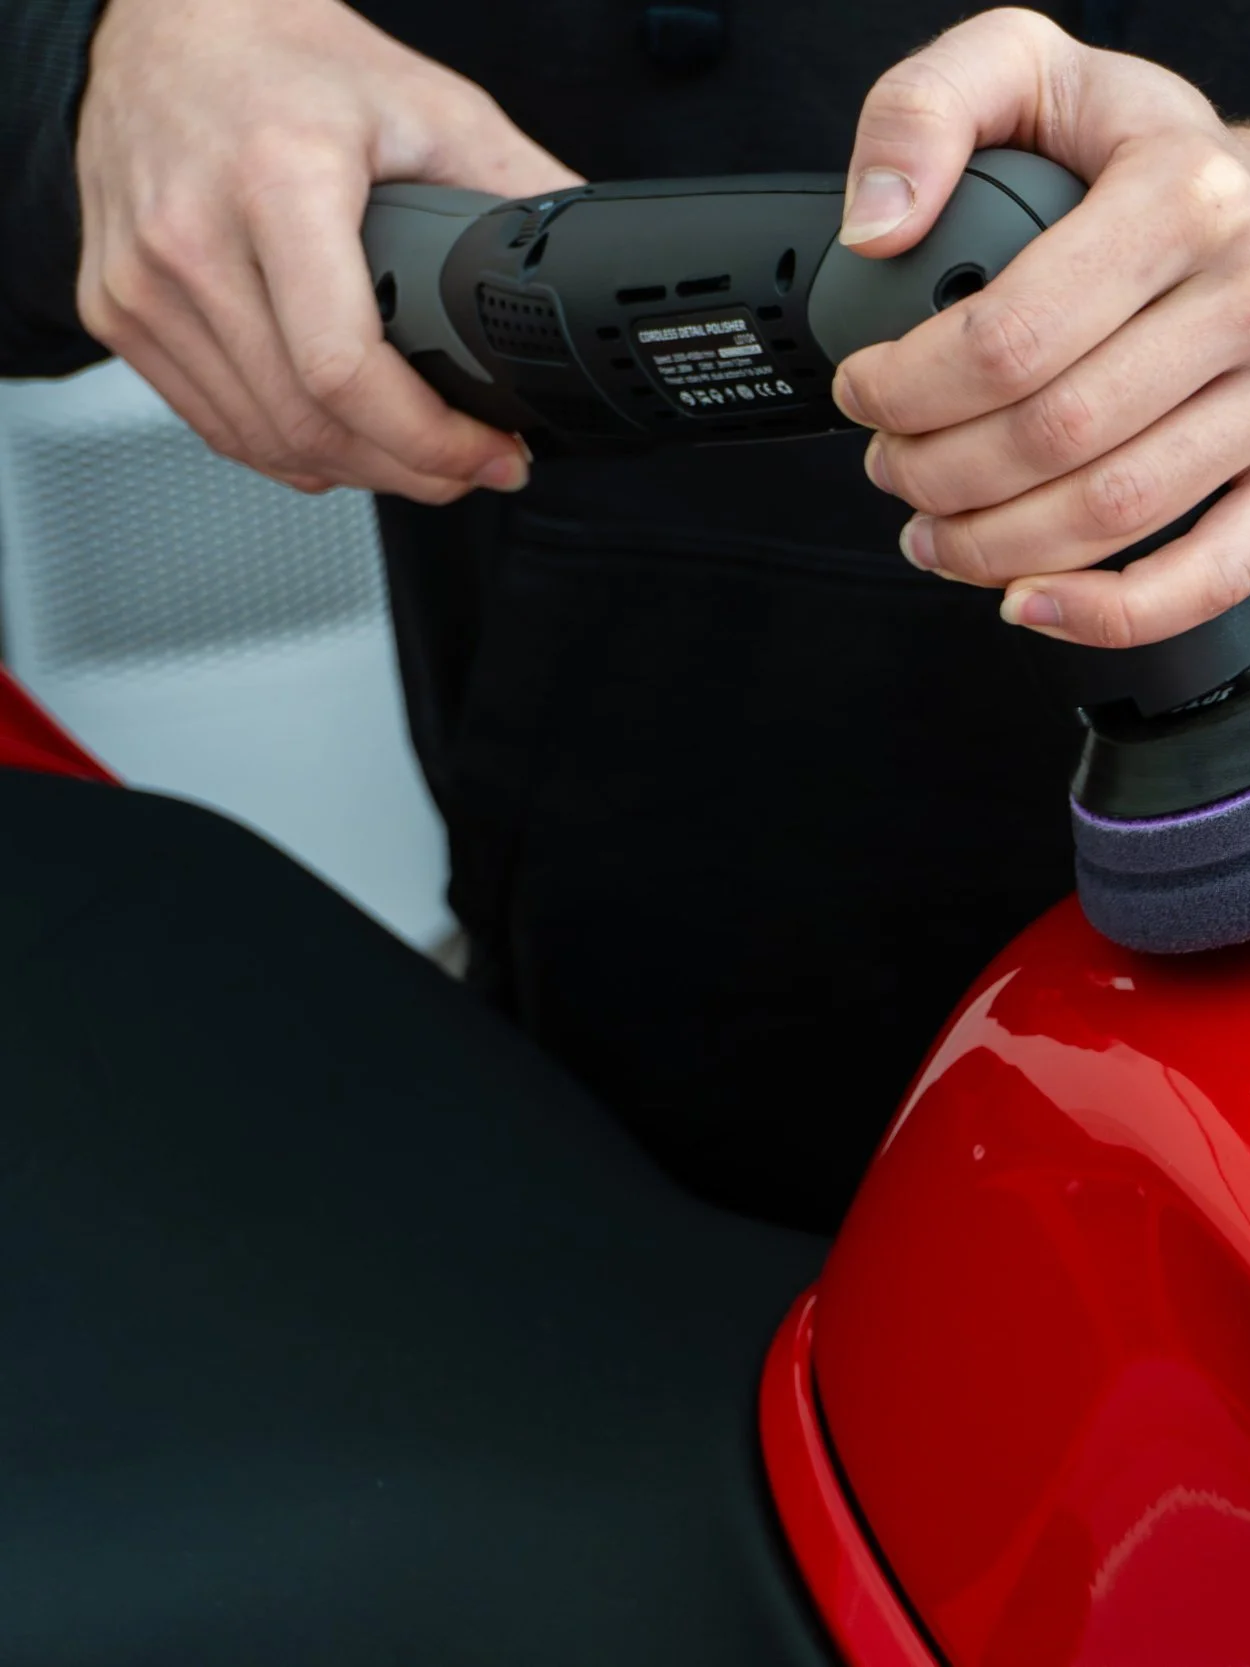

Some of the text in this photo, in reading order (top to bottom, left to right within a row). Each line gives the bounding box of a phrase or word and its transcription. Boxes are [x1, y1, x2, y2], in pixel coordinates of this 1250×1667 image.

[638, 319, 747, 343] CORDLESS DETAIL POLISHER
